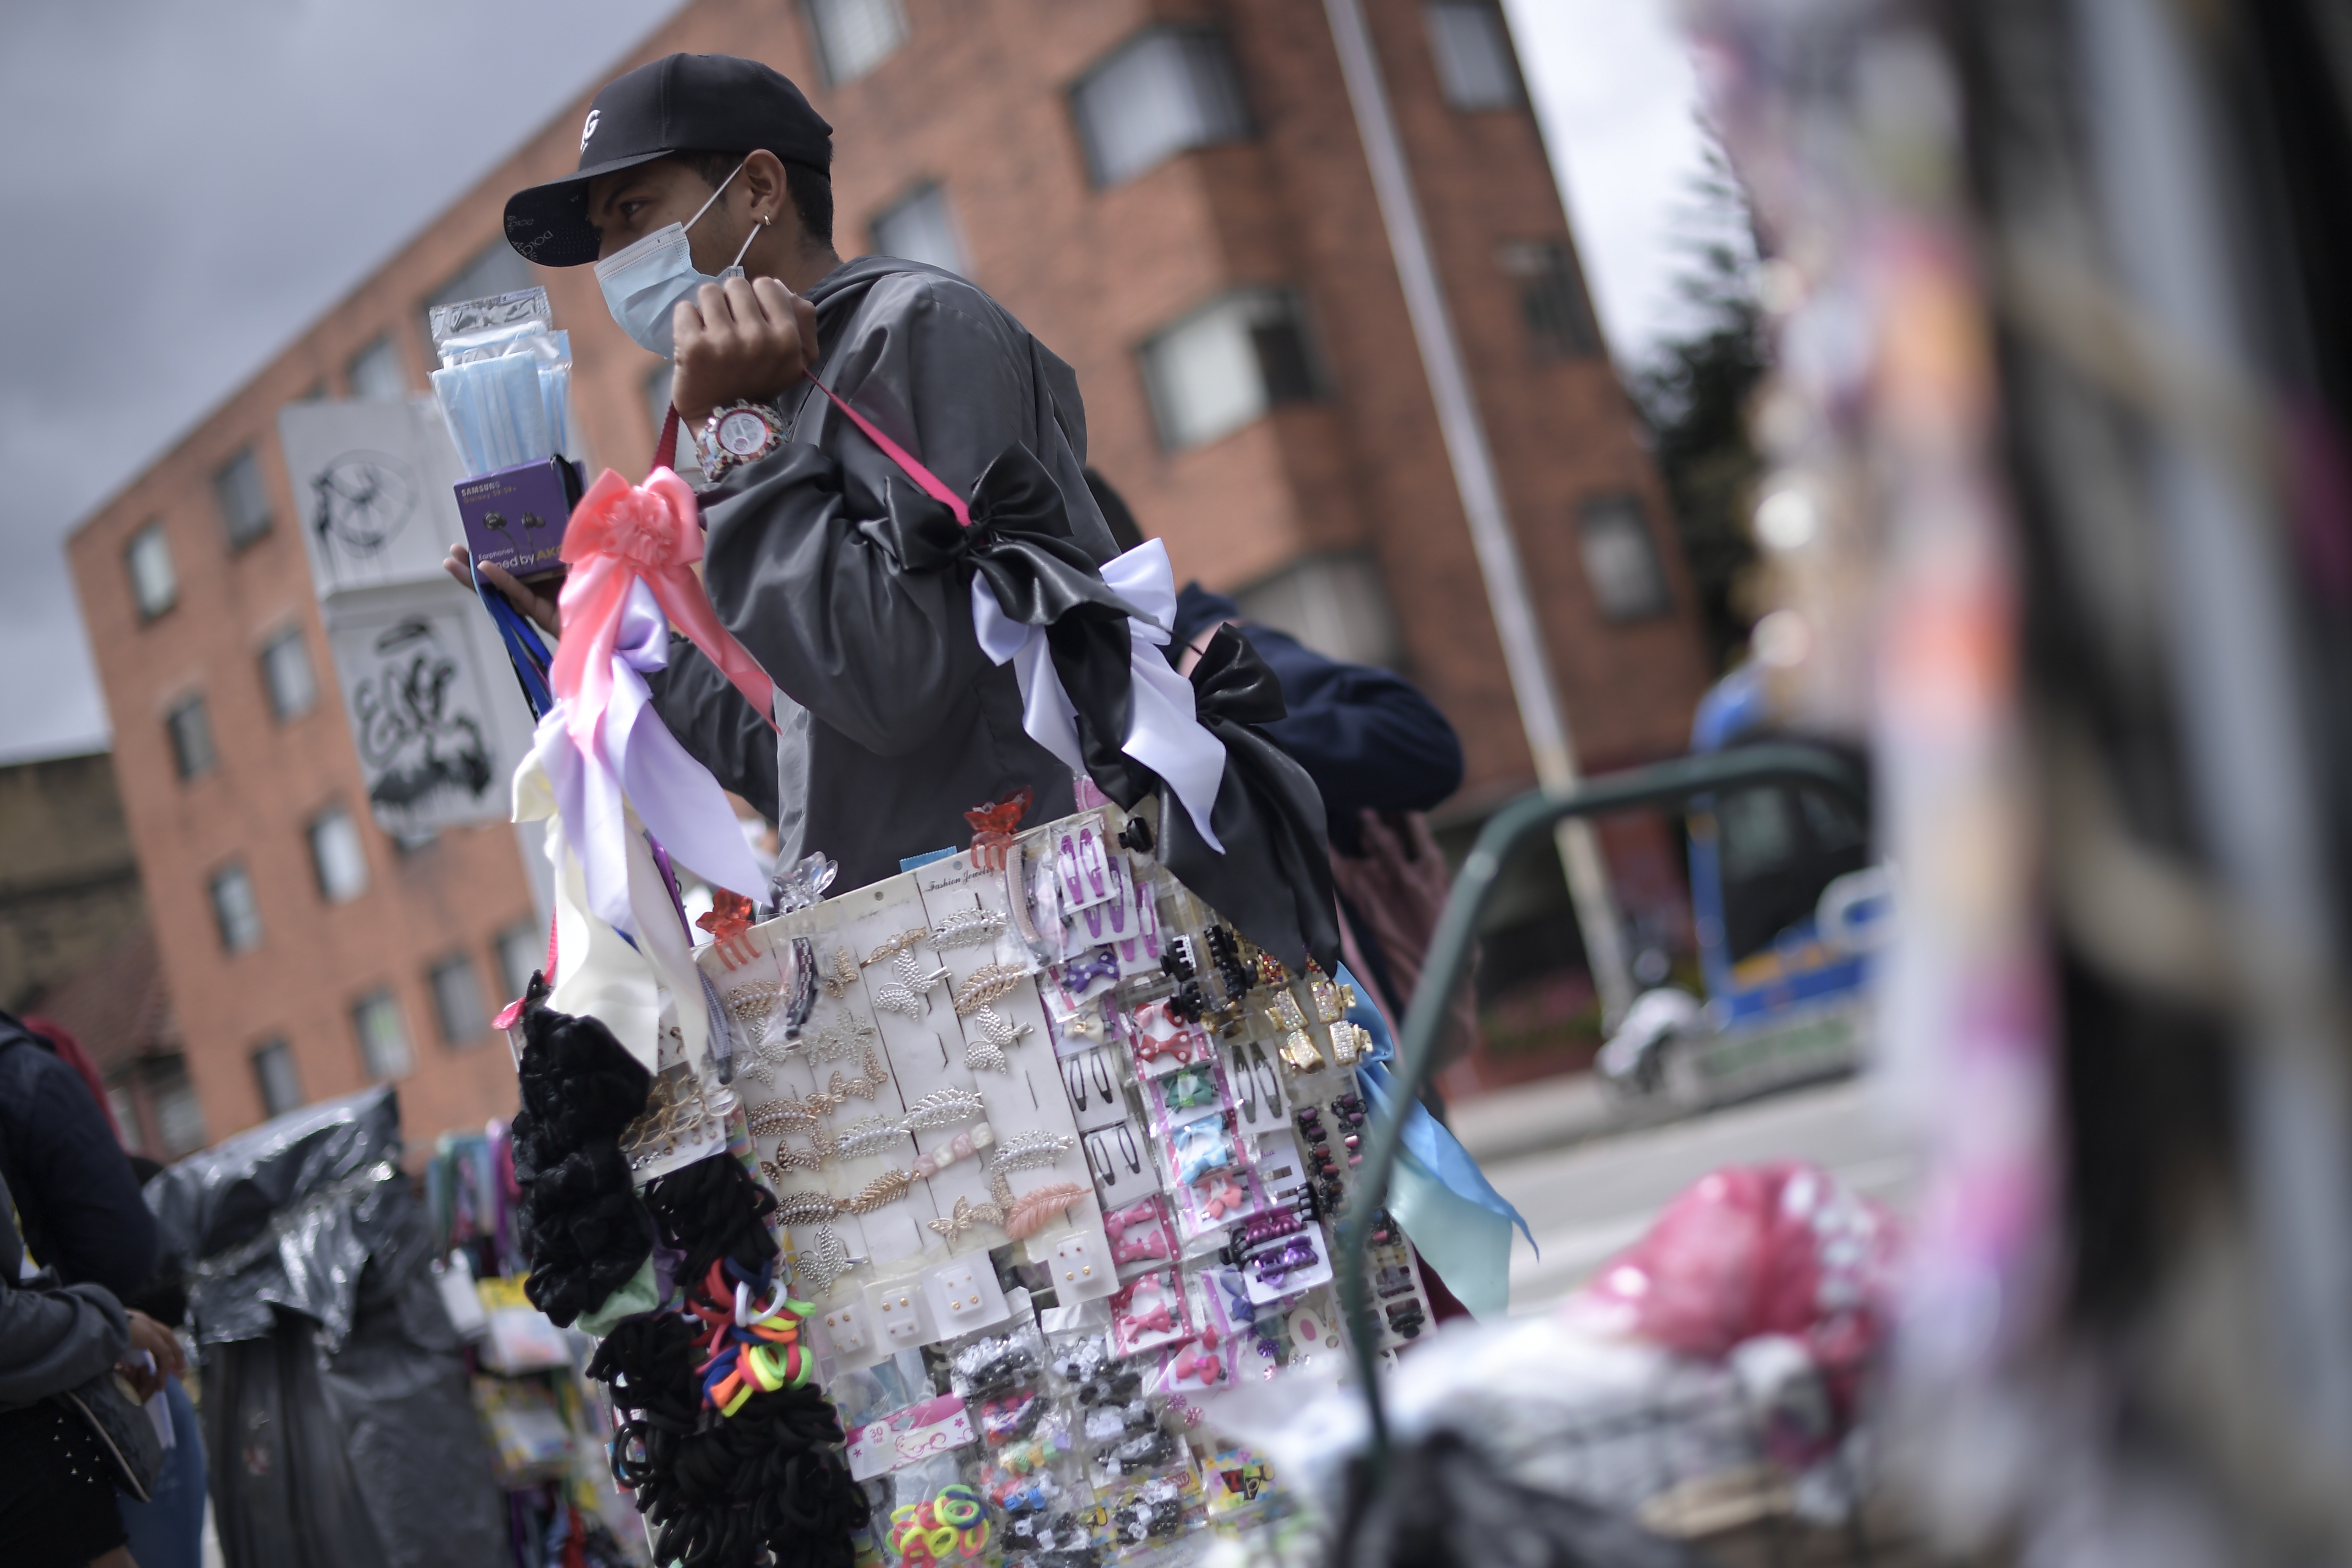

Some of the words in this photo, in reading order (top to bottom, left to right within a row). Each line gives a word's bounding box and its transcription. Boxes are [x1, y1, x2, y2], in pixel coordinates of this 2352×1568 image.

[520, 231, 553, 256] DOLCE
[461, 481, 500, 497] SAMSUNG
[463, 493, 490, 504] Galaxy
[478, 547, 514, 561] Earphones
[520, 553, 534, 565] by
[924, 878, 961, 892] Fashion
[963, 866, 994, 885] Jewelry
[870, 1426, 883, 1438] 30
